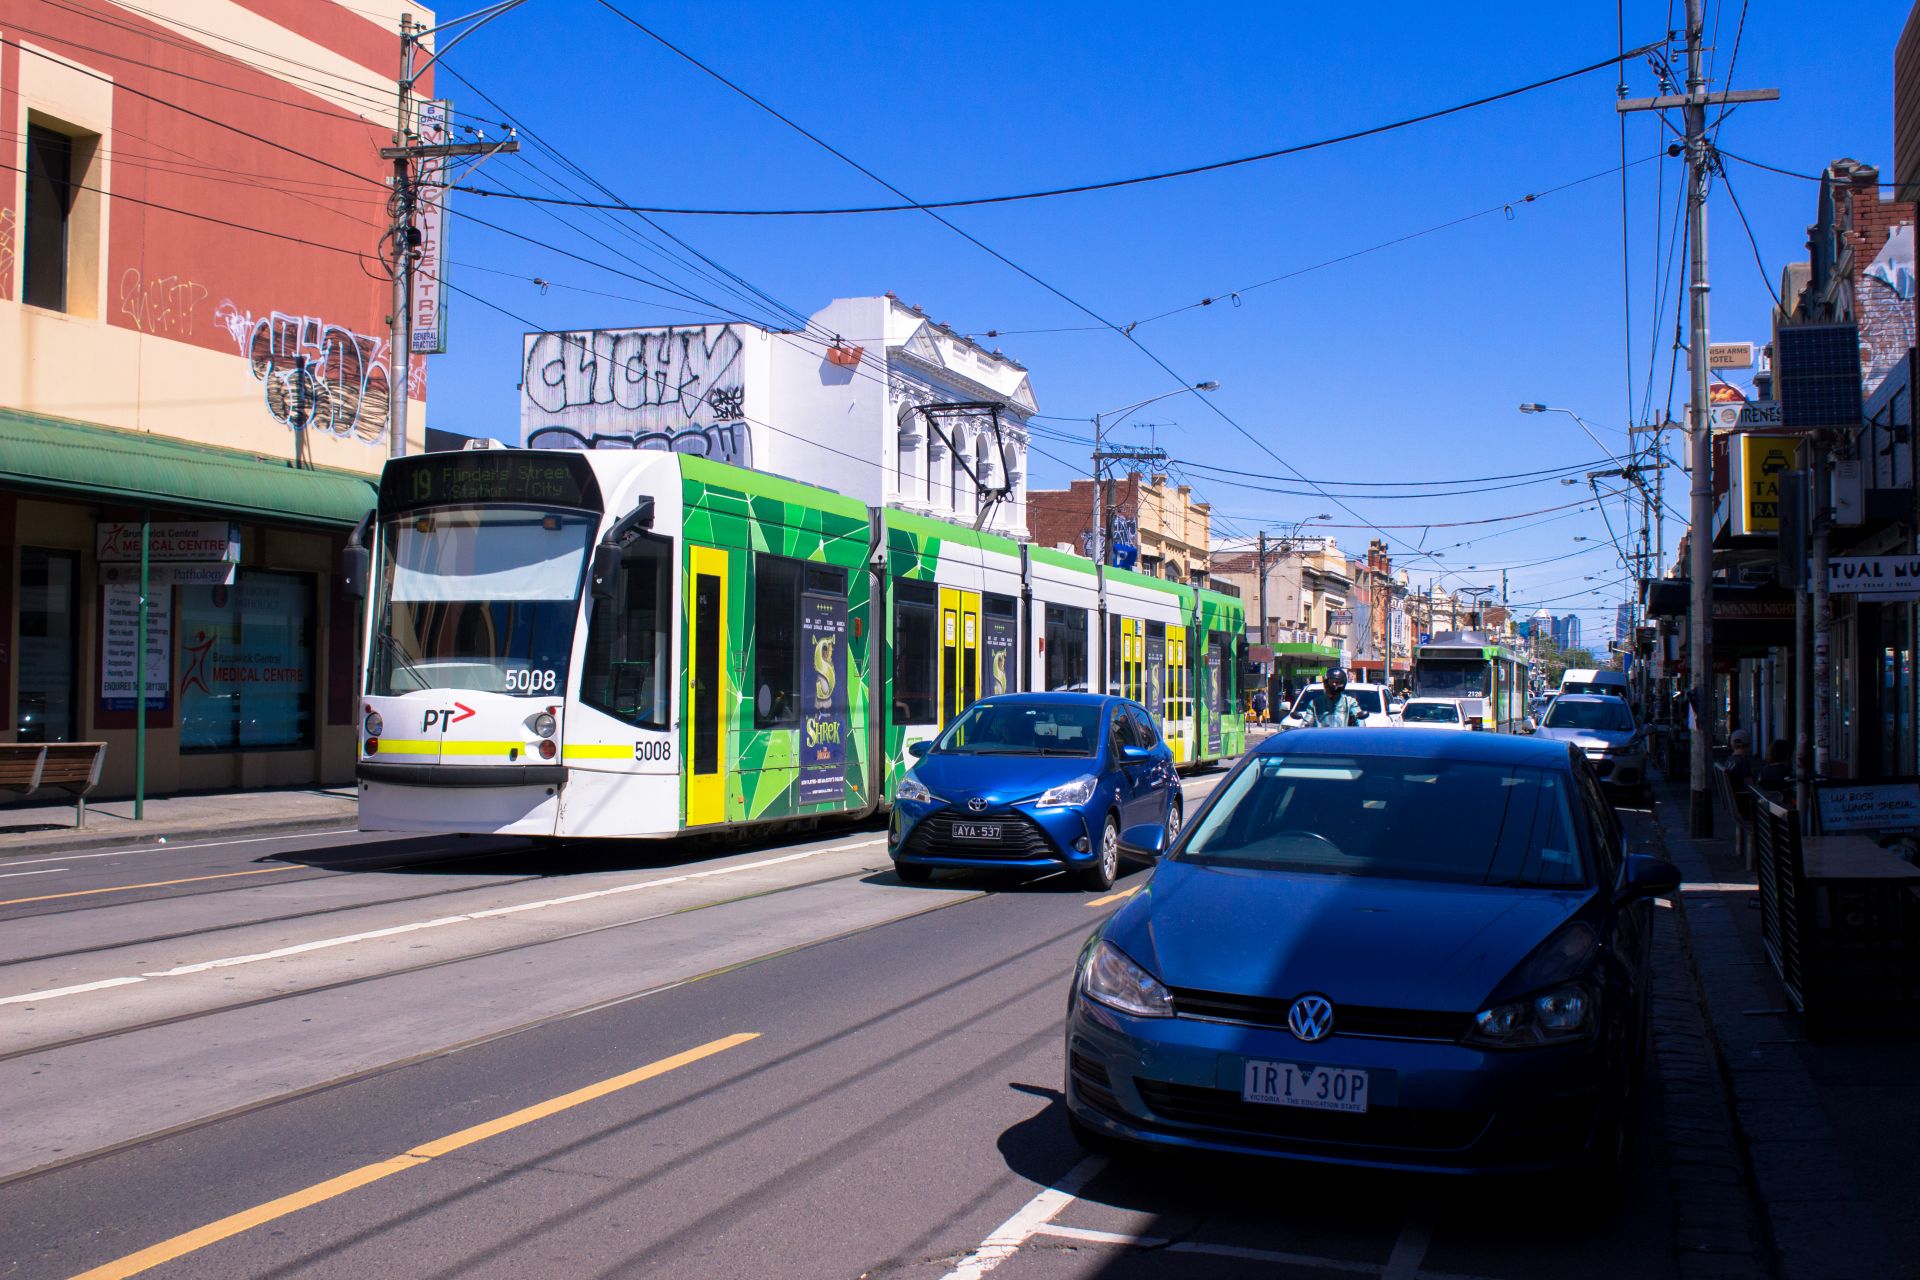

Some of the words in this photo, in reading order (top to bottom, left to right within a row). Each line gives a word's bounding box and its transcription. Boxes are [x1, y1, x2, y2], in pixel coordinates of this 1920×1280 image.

[426, 106, 435, 115] 6
[420, 115, 444, 124] DAYS
[418, 239, 436, 326] CENTRE
[413, 332, 437, 342] GENERAL
[412, 341, 437, 350] PRACTICE
[1728, 347, 1748, 355] ARMS
[410, 467, 432, 499] 19
[442, 466, 511, 482] Flinders
[452, 482, 508, 499] Station
[531, 481, 564, 497] City
[168, 529, 199, 538] Central
[123, 540, 174, 551] MEICAL
[178, 540, 225, 551] CENTRE
[174, 568, 224, 583] Pathology
[213, 668, 263, 681] MEDICAL
[265, 668, 305, 682] CENTRE
[505, 669, 556, 691] 5008
[635, 740, 671, 761] 5008
